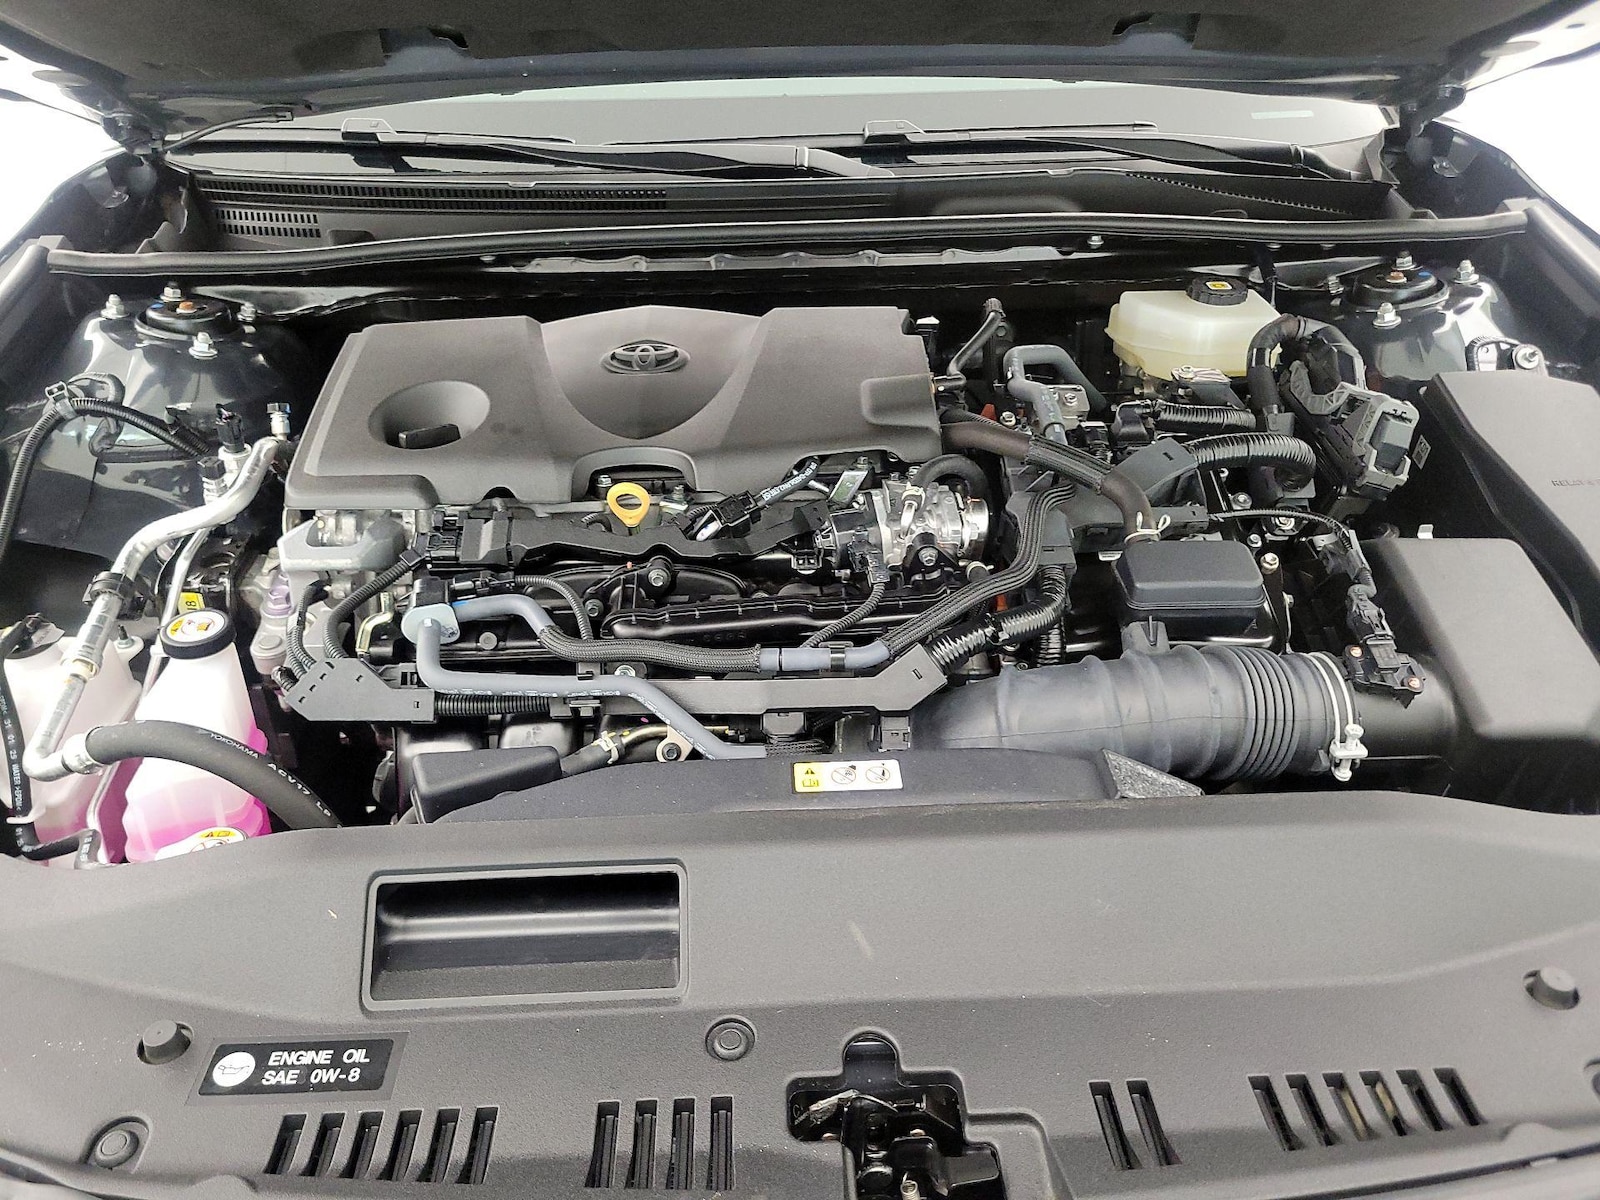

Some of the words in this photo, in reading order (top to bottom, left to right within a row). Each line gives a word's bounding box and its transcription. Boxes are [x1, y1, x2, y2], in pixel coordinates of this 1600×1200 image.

[12, 763, 21, 785] WATER
[210, 733, 259, 759] YOKOHAMA
[267, 762, 312, 796] ACV17
[268, 1050, 335, 1066] ENGINE
[342, 1049, 370, 1063] OIL
[262, 1070, 300, 1086] SAE
[310, 1067, 361, 1084] 0W-8
